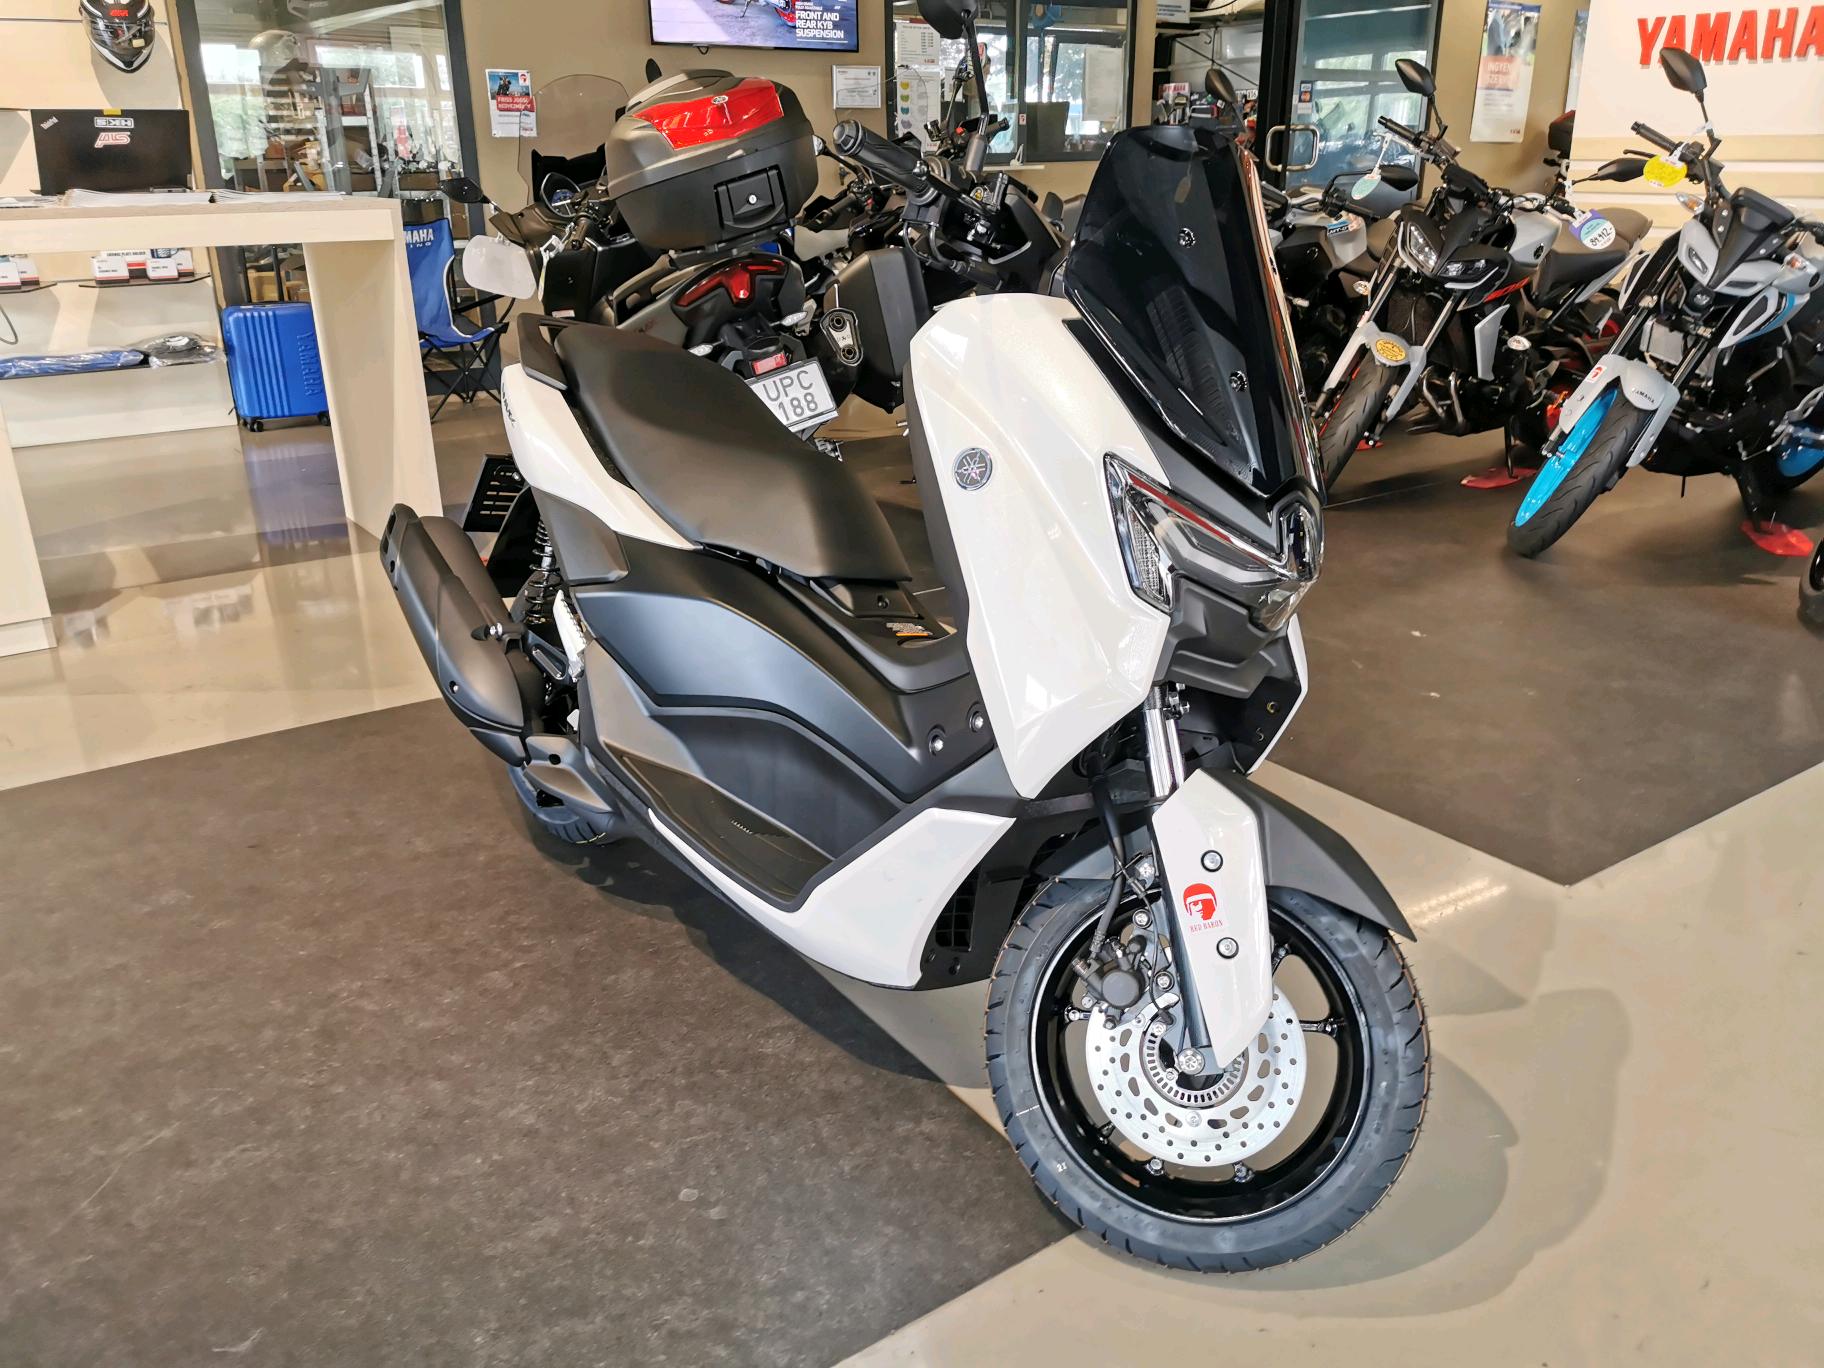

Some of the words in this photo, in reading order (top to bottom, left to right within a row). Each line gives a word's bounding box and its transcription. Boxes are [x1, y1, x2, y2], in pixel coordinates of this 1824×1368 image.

[795, 10, 822, 20] FRONT
[823, 11, 840, 21] AND
[795, 19, 817, 29] REAR
[817, 20, 833, 30] KYB
[795, 28, 845, 39] SUSPENSION
[1637, 5, 1824, 66] YAMAHA
[405, 228, 434, 244] MAHA
[763, 370, 813, 402] UPC
[778, 392, 818, 421] 188
